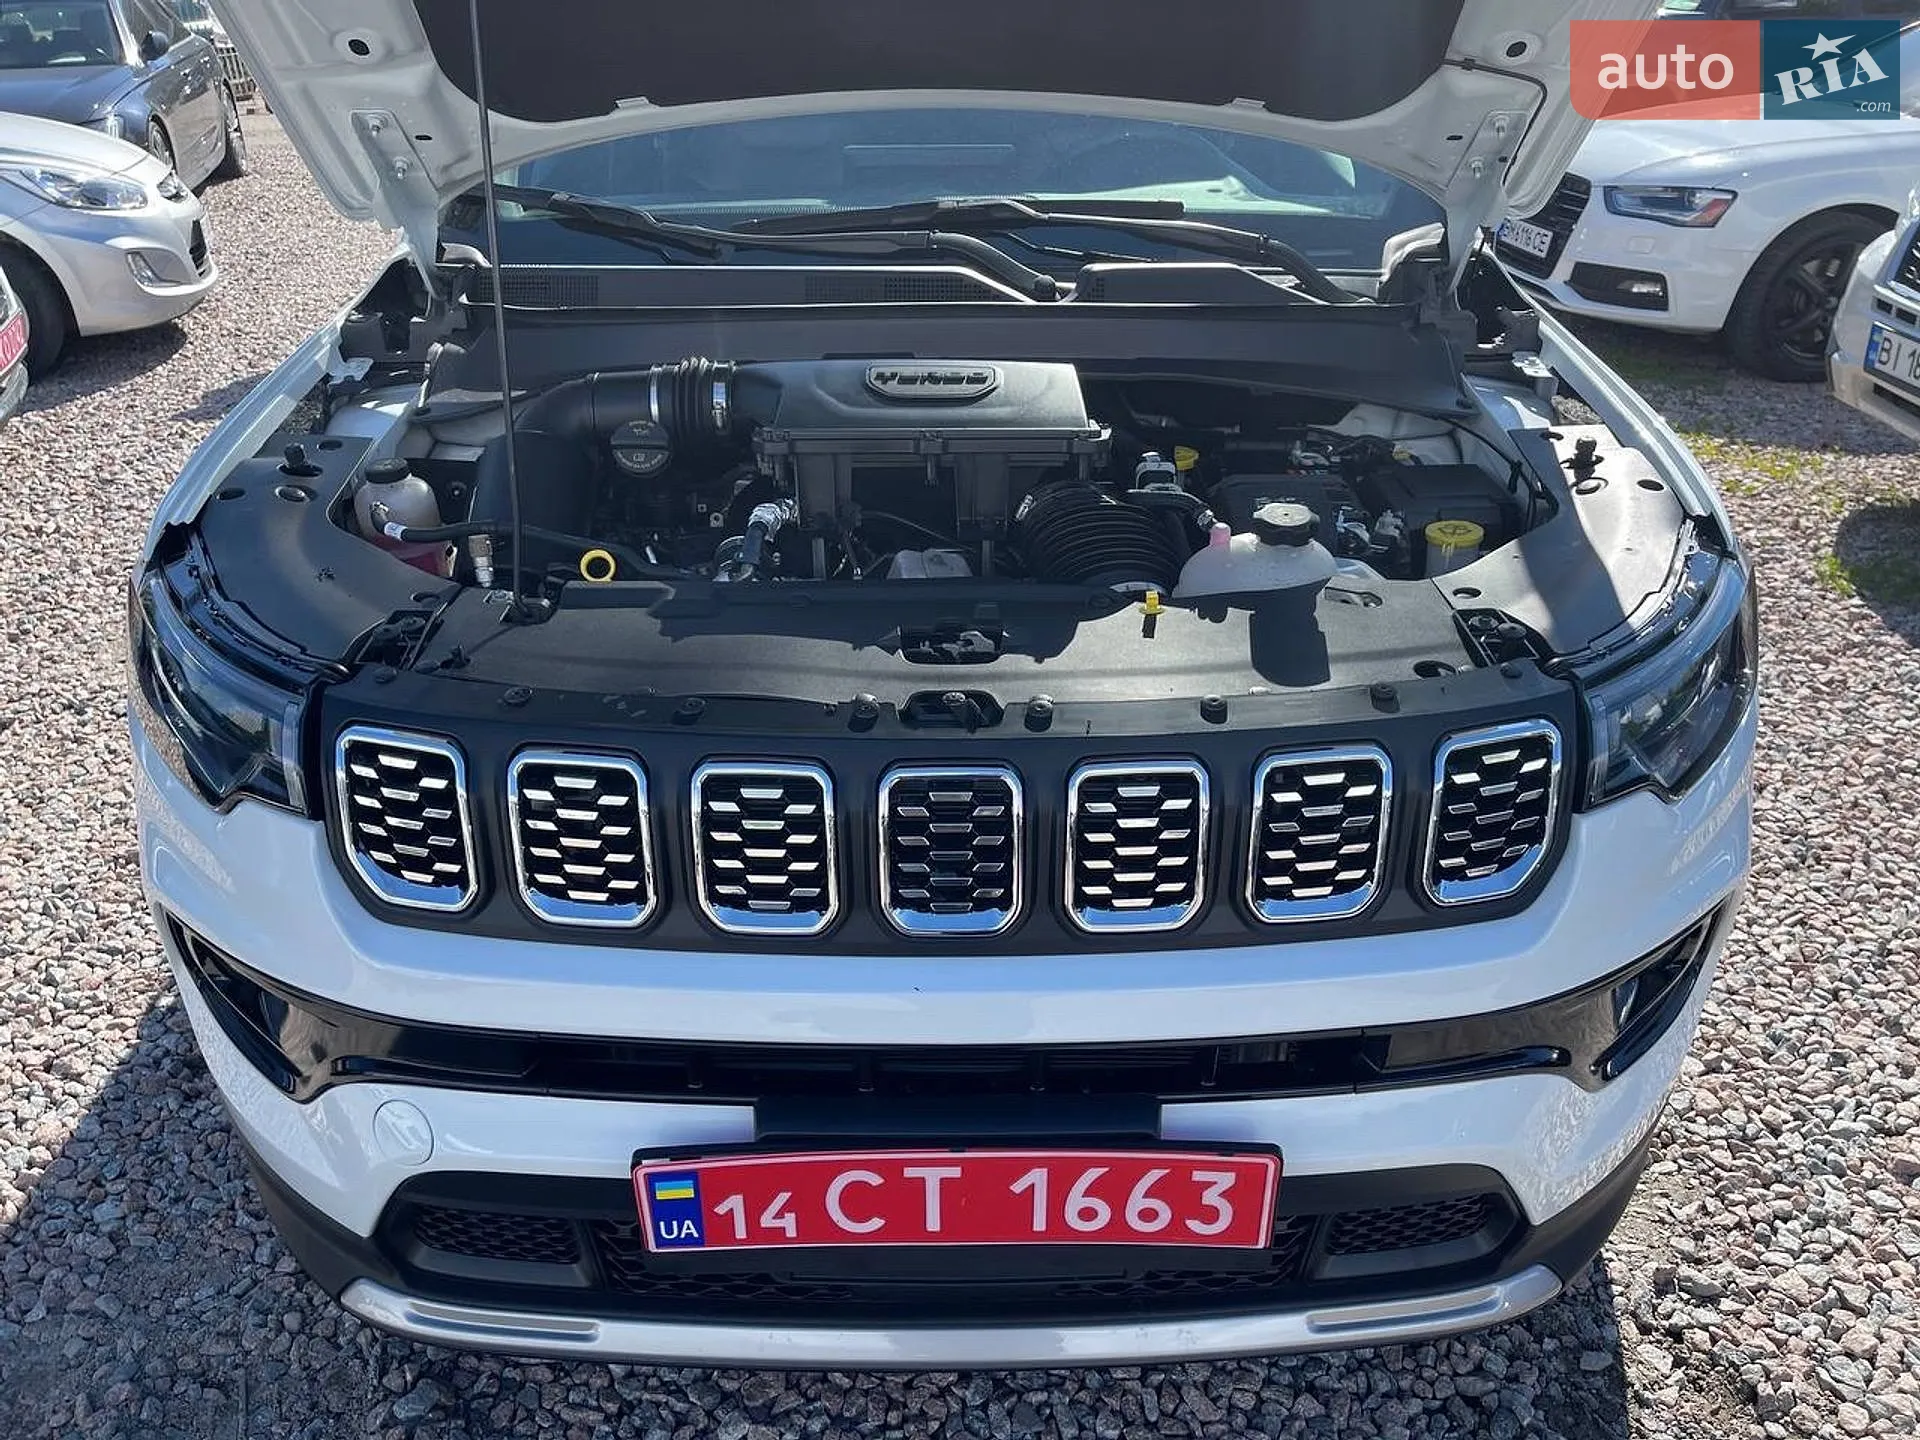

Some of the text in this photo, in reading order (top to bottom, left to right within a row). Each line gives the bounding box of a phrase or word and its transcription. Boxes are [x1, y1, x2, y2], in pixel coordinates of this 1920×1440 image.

[659, 1167, 1237, 1240] UA 14 CT 1663
